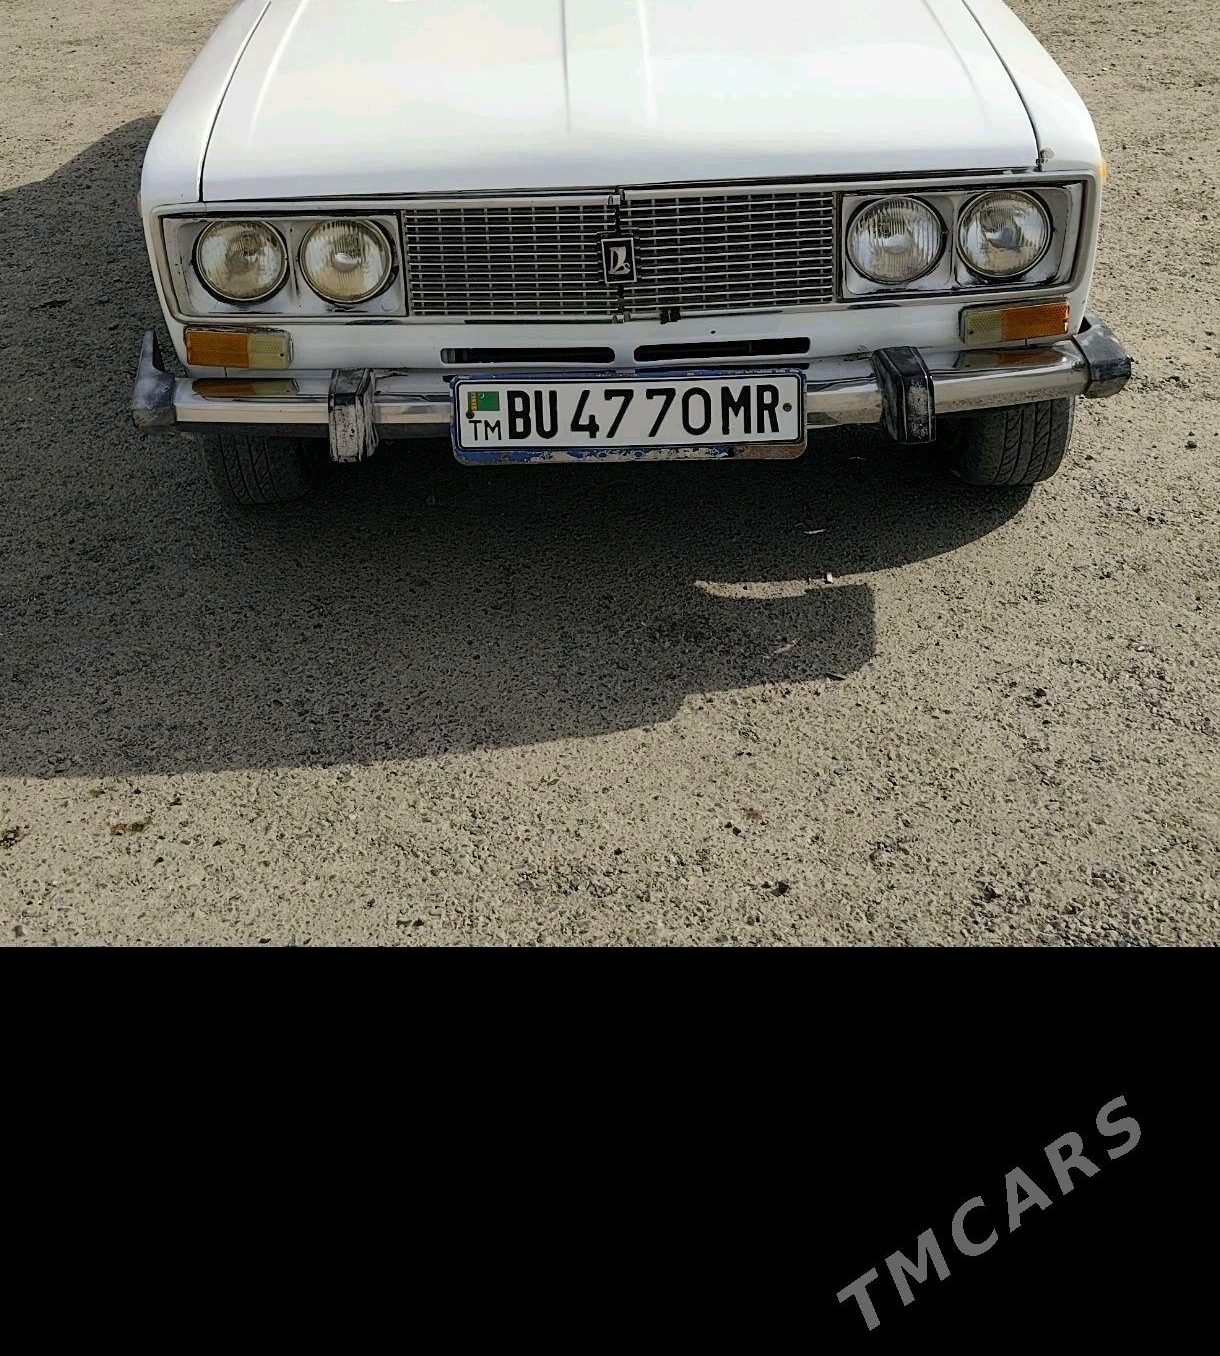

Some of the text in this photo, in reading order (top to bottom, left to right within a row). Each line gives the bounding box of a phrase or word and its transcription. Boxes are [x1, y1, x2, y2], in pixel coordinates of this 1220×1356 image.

[468, 419, 502, 441] TM
[506, 384, 780, 440] BU 4770 MR
